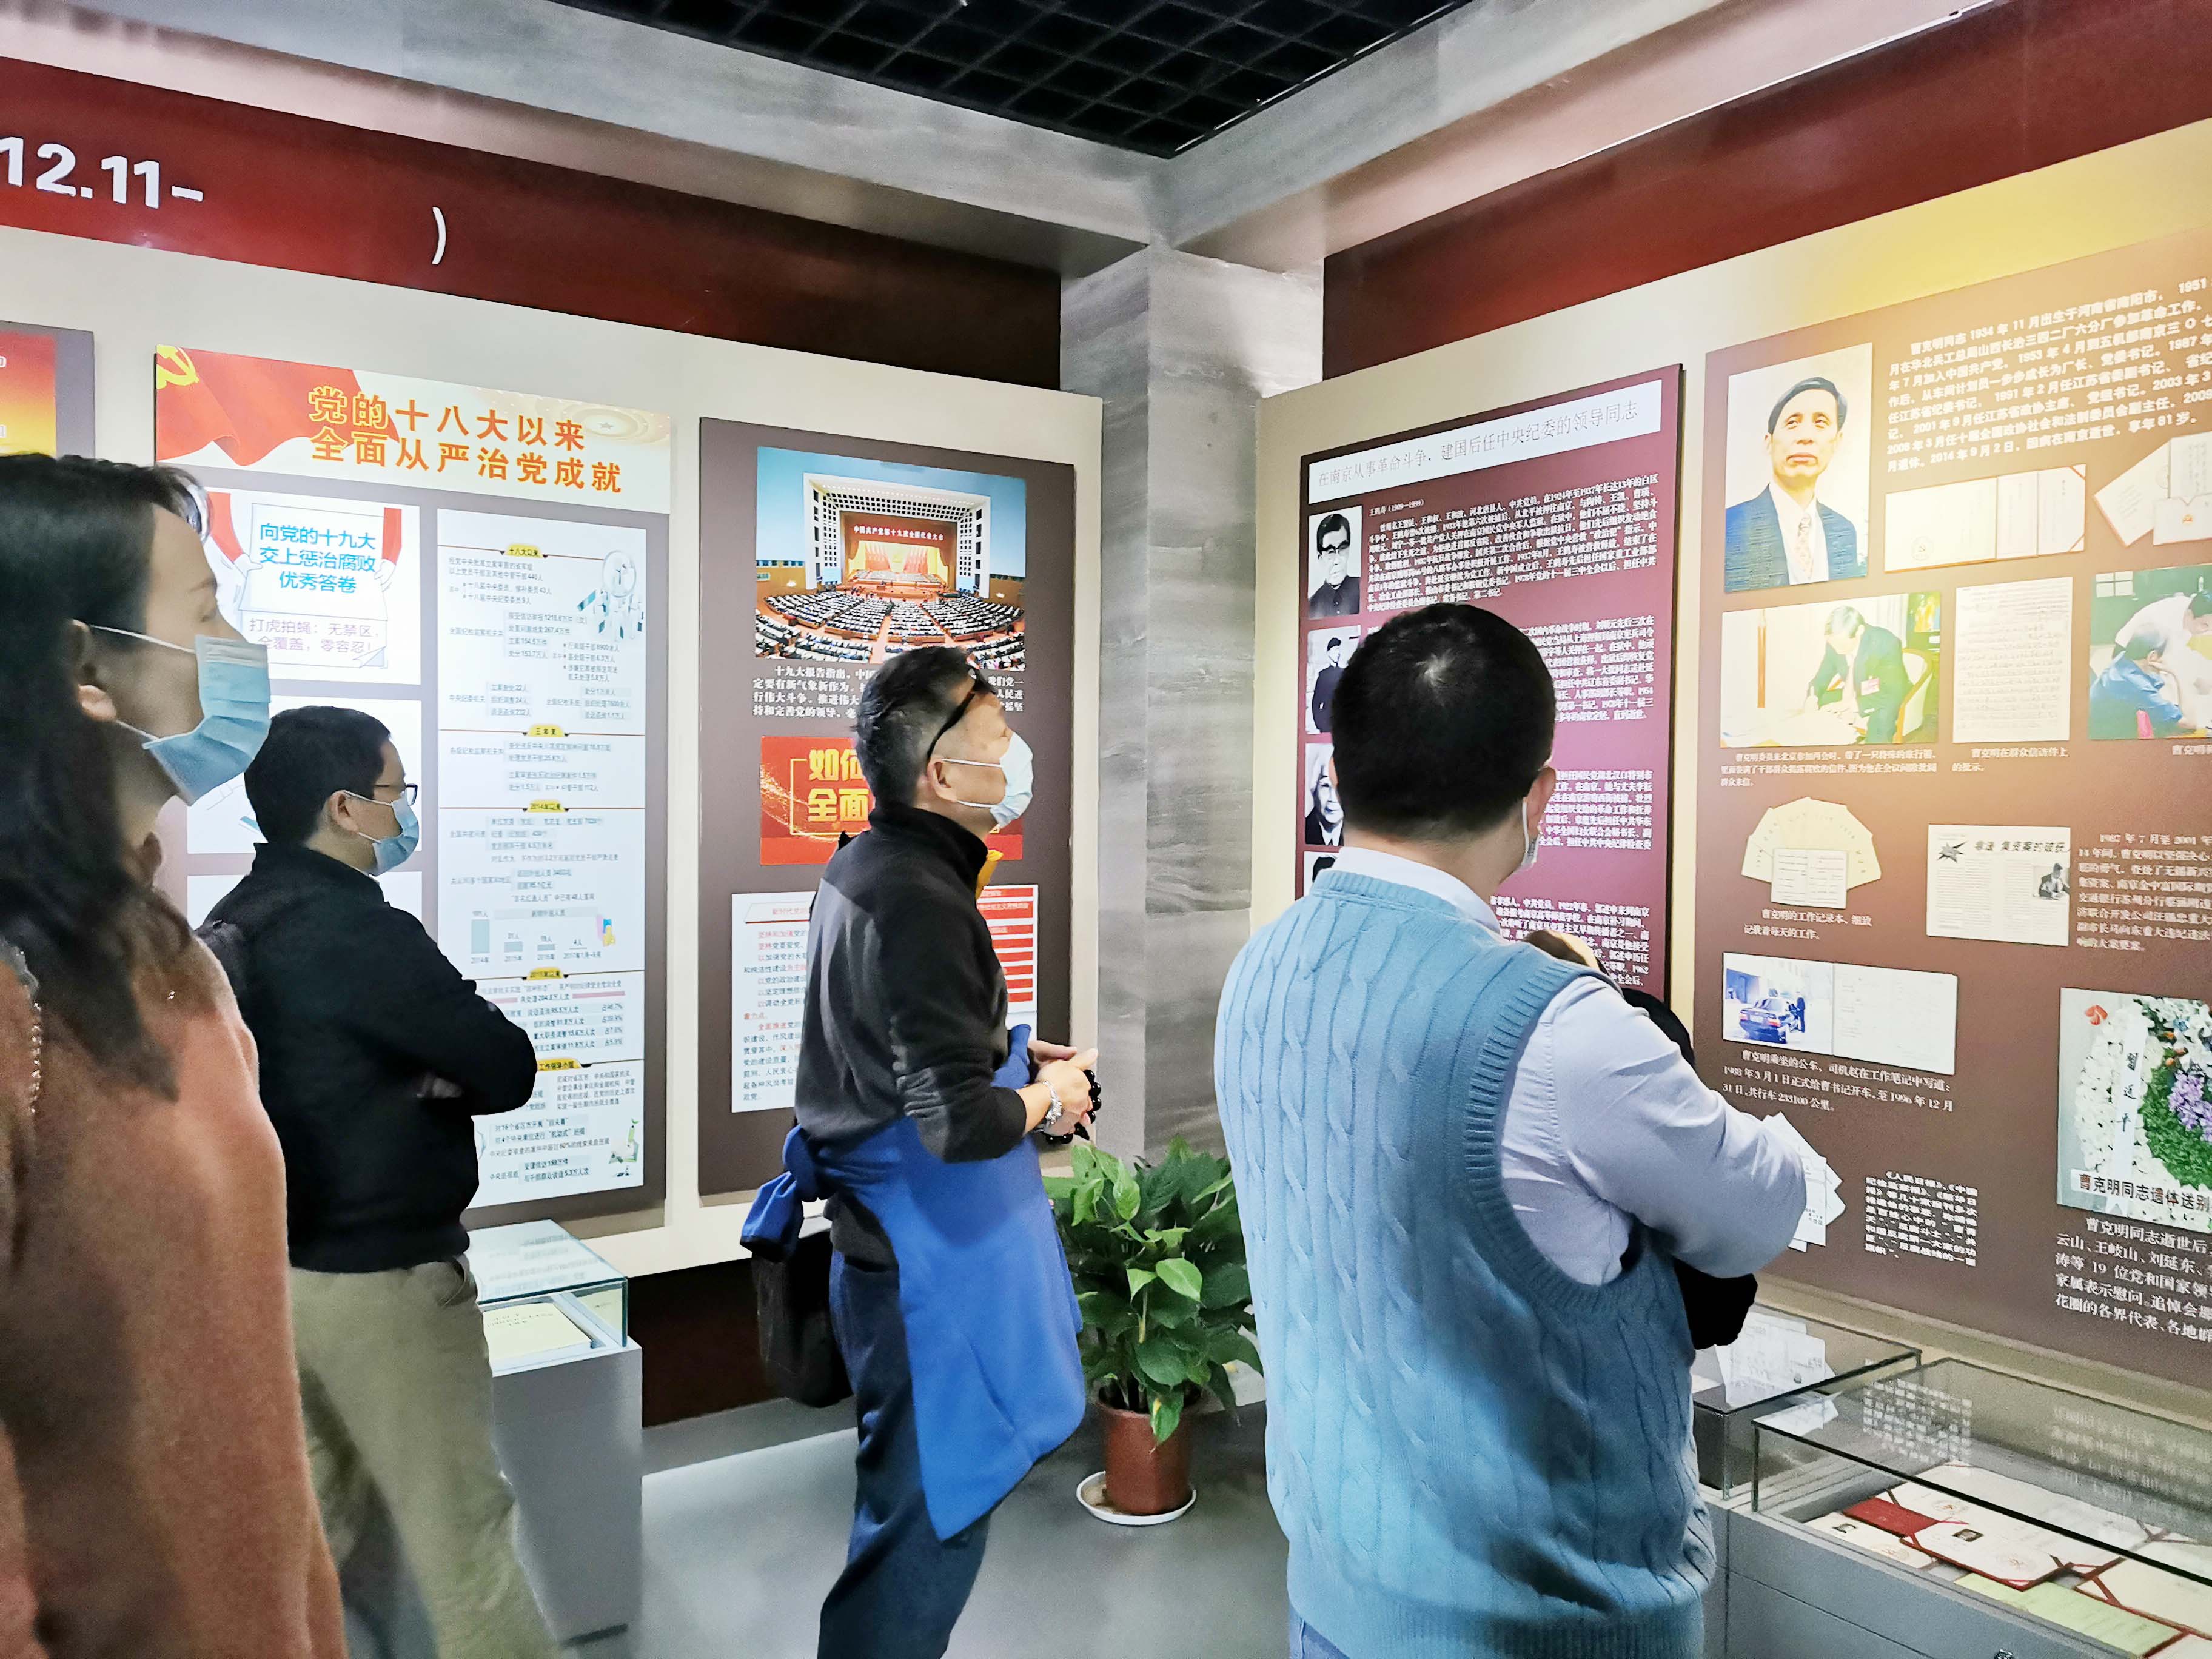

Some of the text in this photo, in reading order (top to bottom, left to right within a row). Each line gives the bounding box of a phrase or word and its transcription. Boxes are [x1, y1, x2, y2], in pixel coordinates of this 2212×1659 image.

[308, 386, 585, 451] 党的十八大以来
[310, 426, 622, 493] 全面从严治党成就
[260, 523, 376, 550] 向党的十九大
[260, 546, 376, 572] 交上惩治腐败
[279, 571, 357, 594] 优秀答卷
[808, 788, 870, 823] 全面
